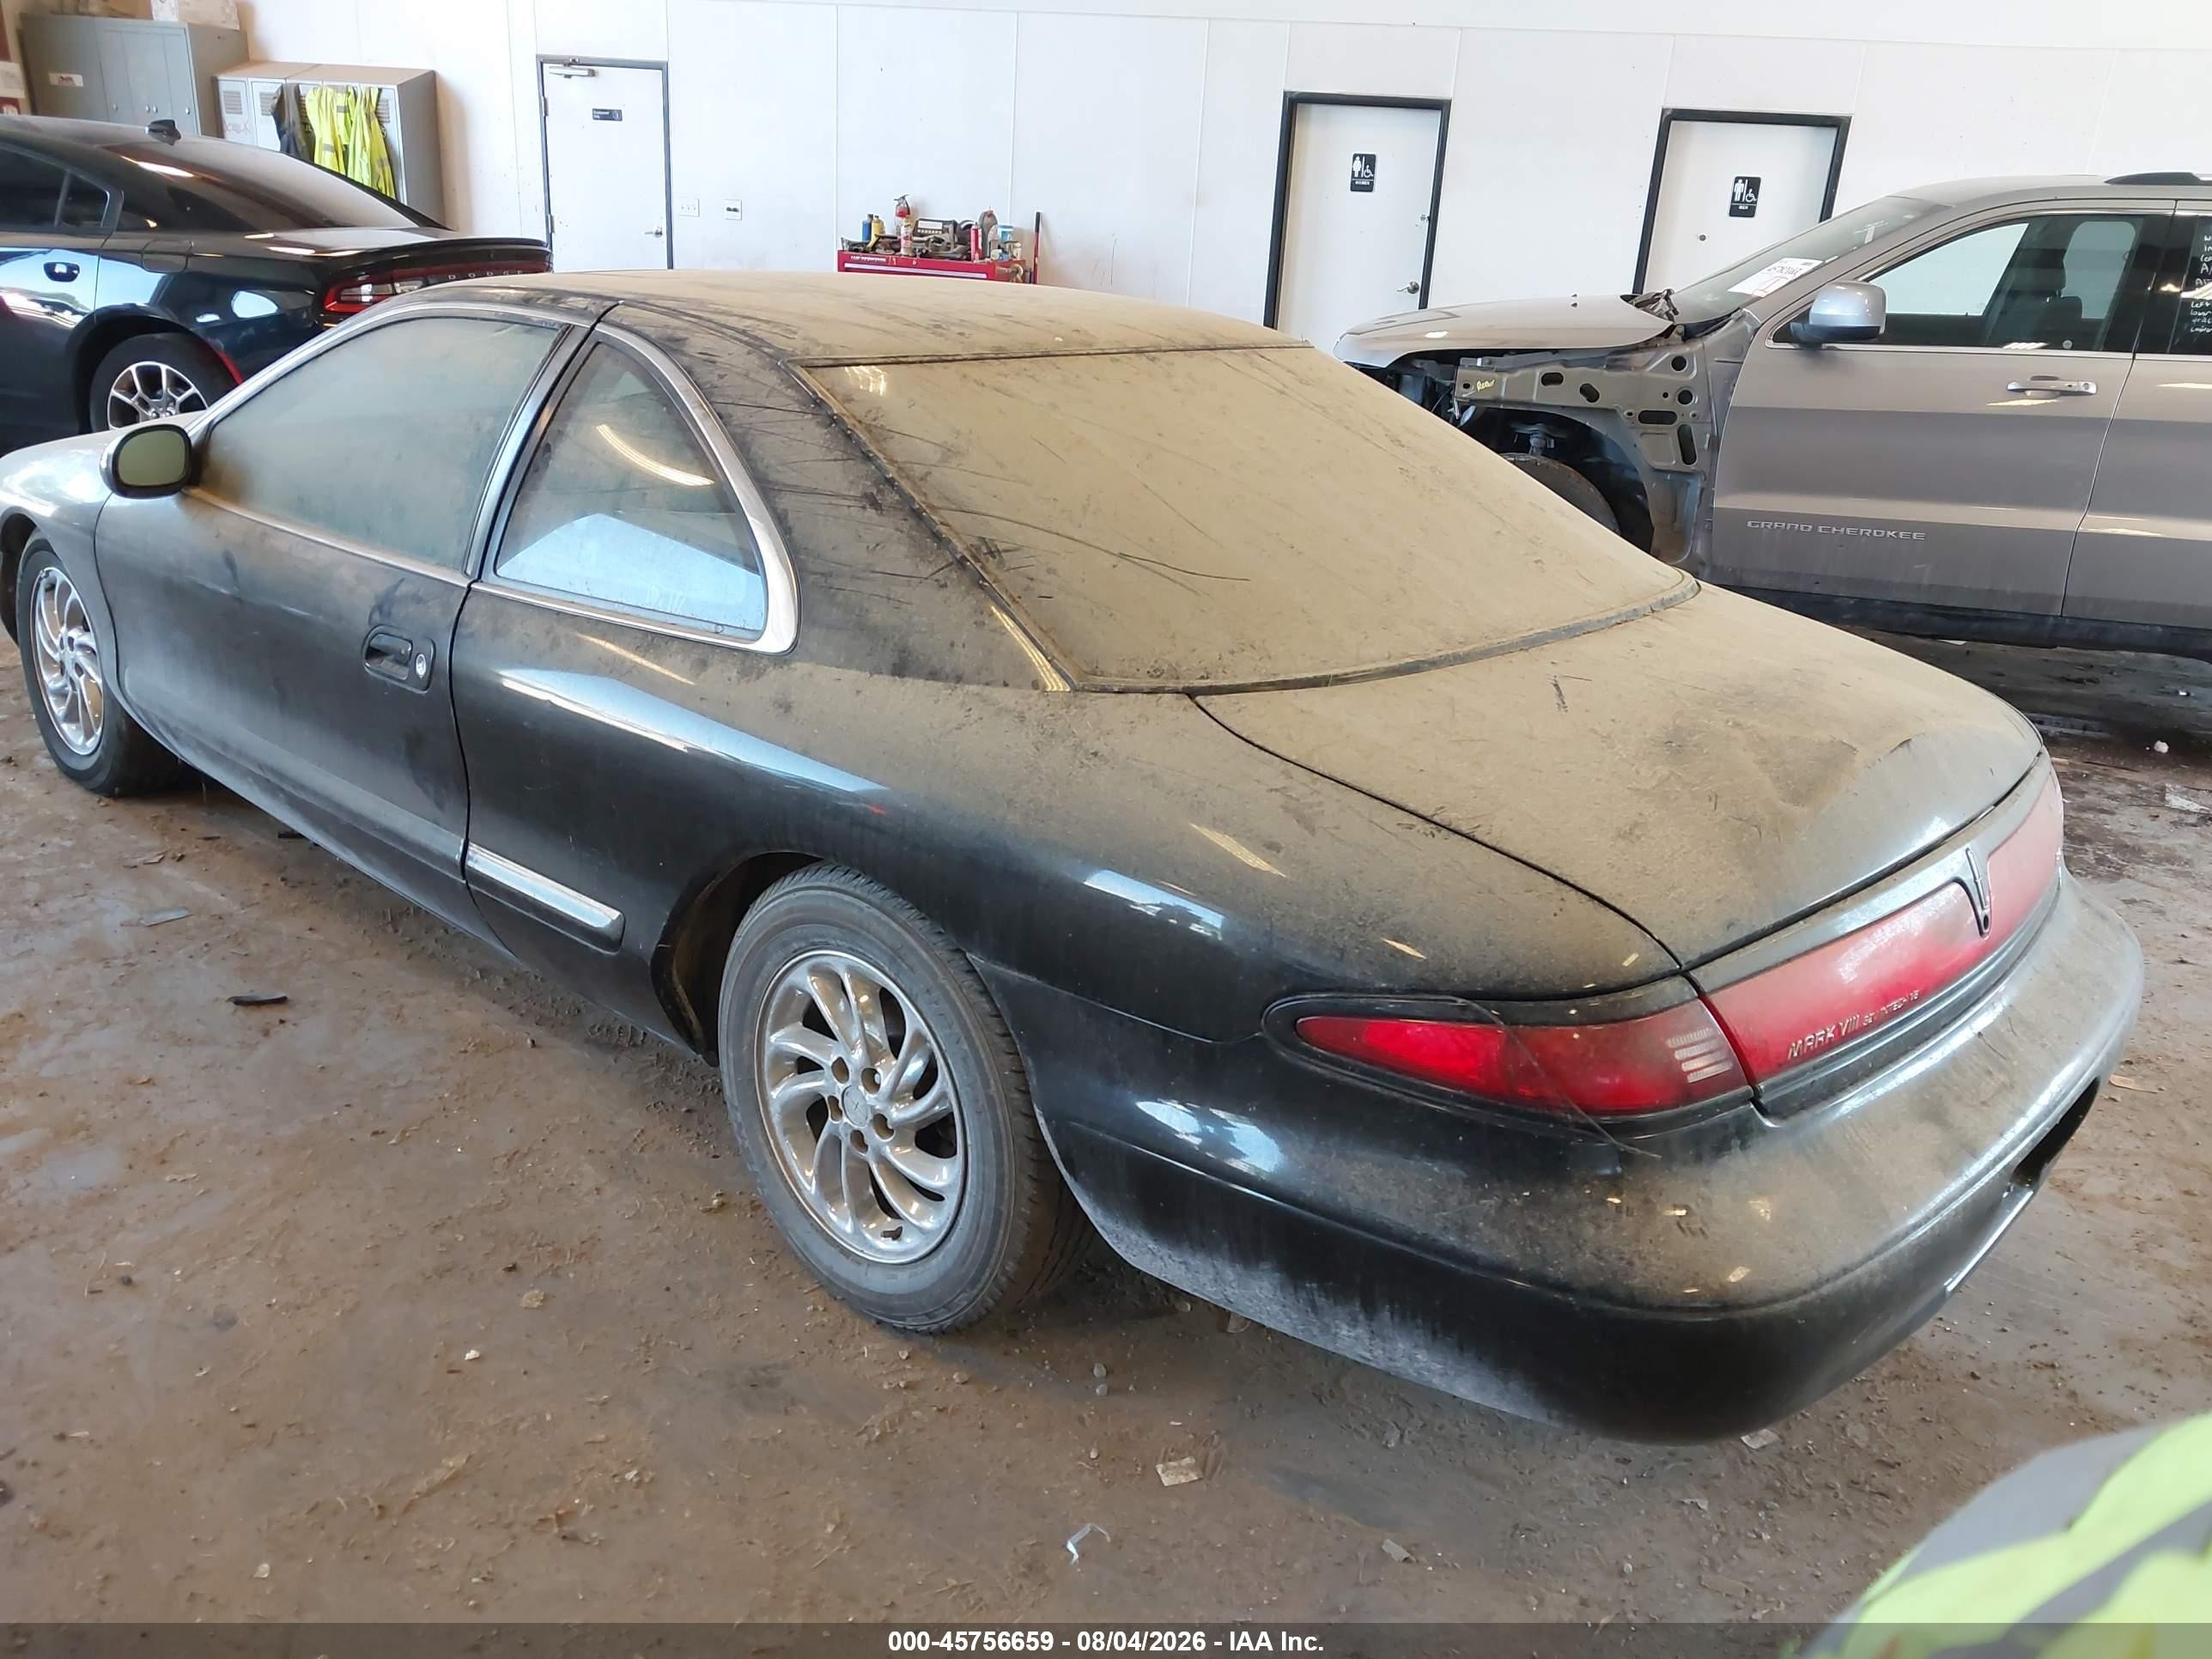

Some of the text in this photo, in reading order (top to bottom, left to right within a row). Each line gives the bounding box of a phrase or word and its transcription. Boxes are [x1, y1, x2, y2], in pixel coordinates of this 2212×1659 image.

[1747, 520, 1926, 540] GRAND CHEROKEE
[1787, 1024, 1836, 1060] MARK
[1838, 1014, 1861, 1037] VIII
